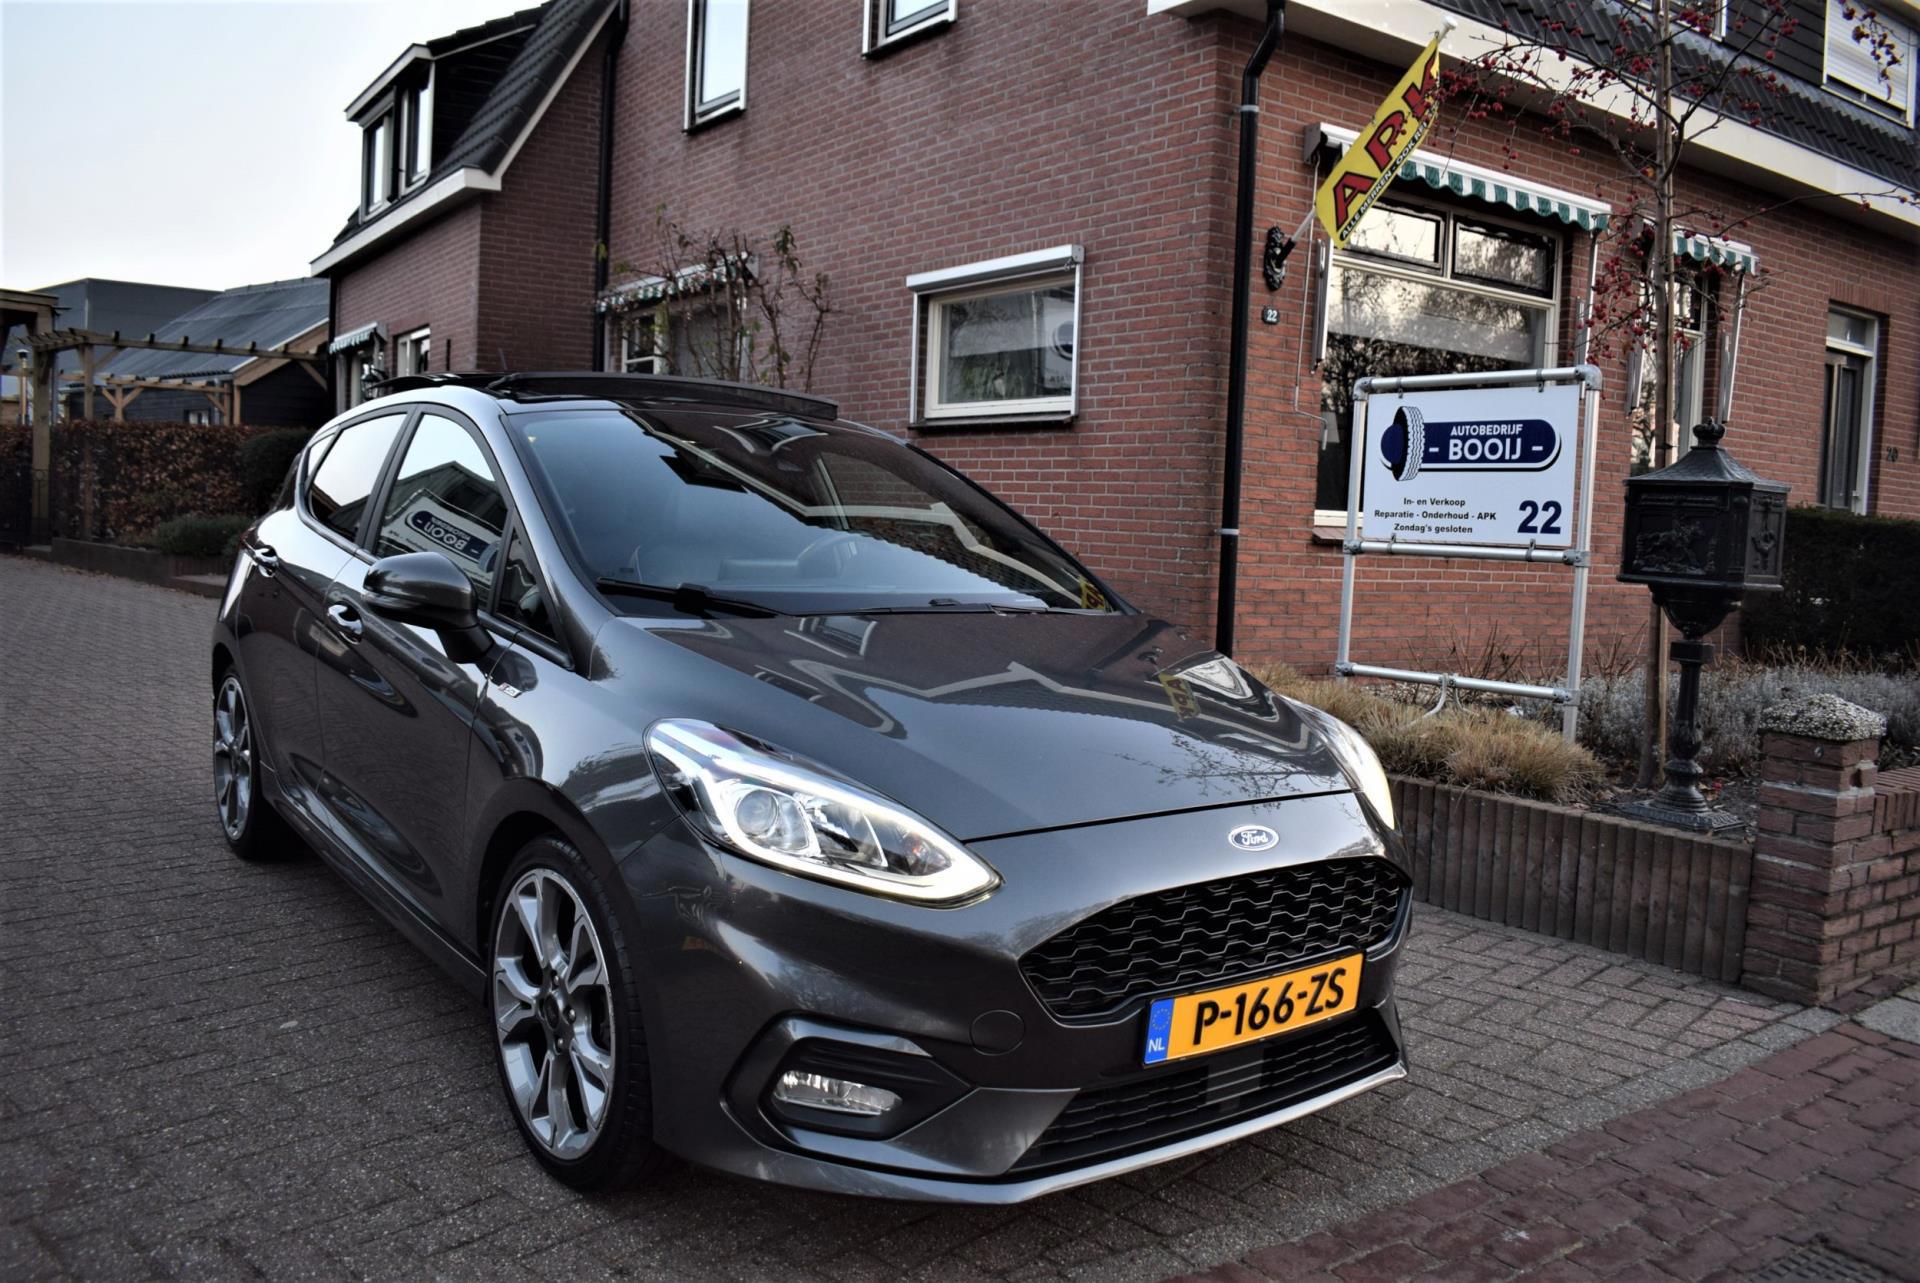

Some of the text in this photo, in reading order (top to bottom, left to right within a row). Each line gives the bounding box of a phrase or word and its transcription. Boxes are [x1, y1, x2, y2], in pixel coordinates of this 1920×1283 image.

[1333, 47, 1437, 232] APK
[1341, 210, 1361, 240] ALLE
[1360, 171, 1392, 215] MERKEN
[1396, 138, 1415, 165] OOK
[1266, 309, 1278, 322] 22
[1450, 424, 1523, 436] AUTOBEDRIJF
[1448, 438, 1522, 461] BOOIJ
[1403, 498, 1415, 506] In-
[1429, 498, 1466, 507] Verkoop
[1374, 510, 1414, 519] Reparatie
[1421, 511, 1469, 520] Onderhoud
[1476, 512, 1497, 521] APK
[1517, 500, 1562, 534] 22
[1394, 523, 1473, 534] Zondag's gesloten
[1193, 968, 1346, 1046] P-166-ZS
[1148, 1037, 1165, 1052] NL
